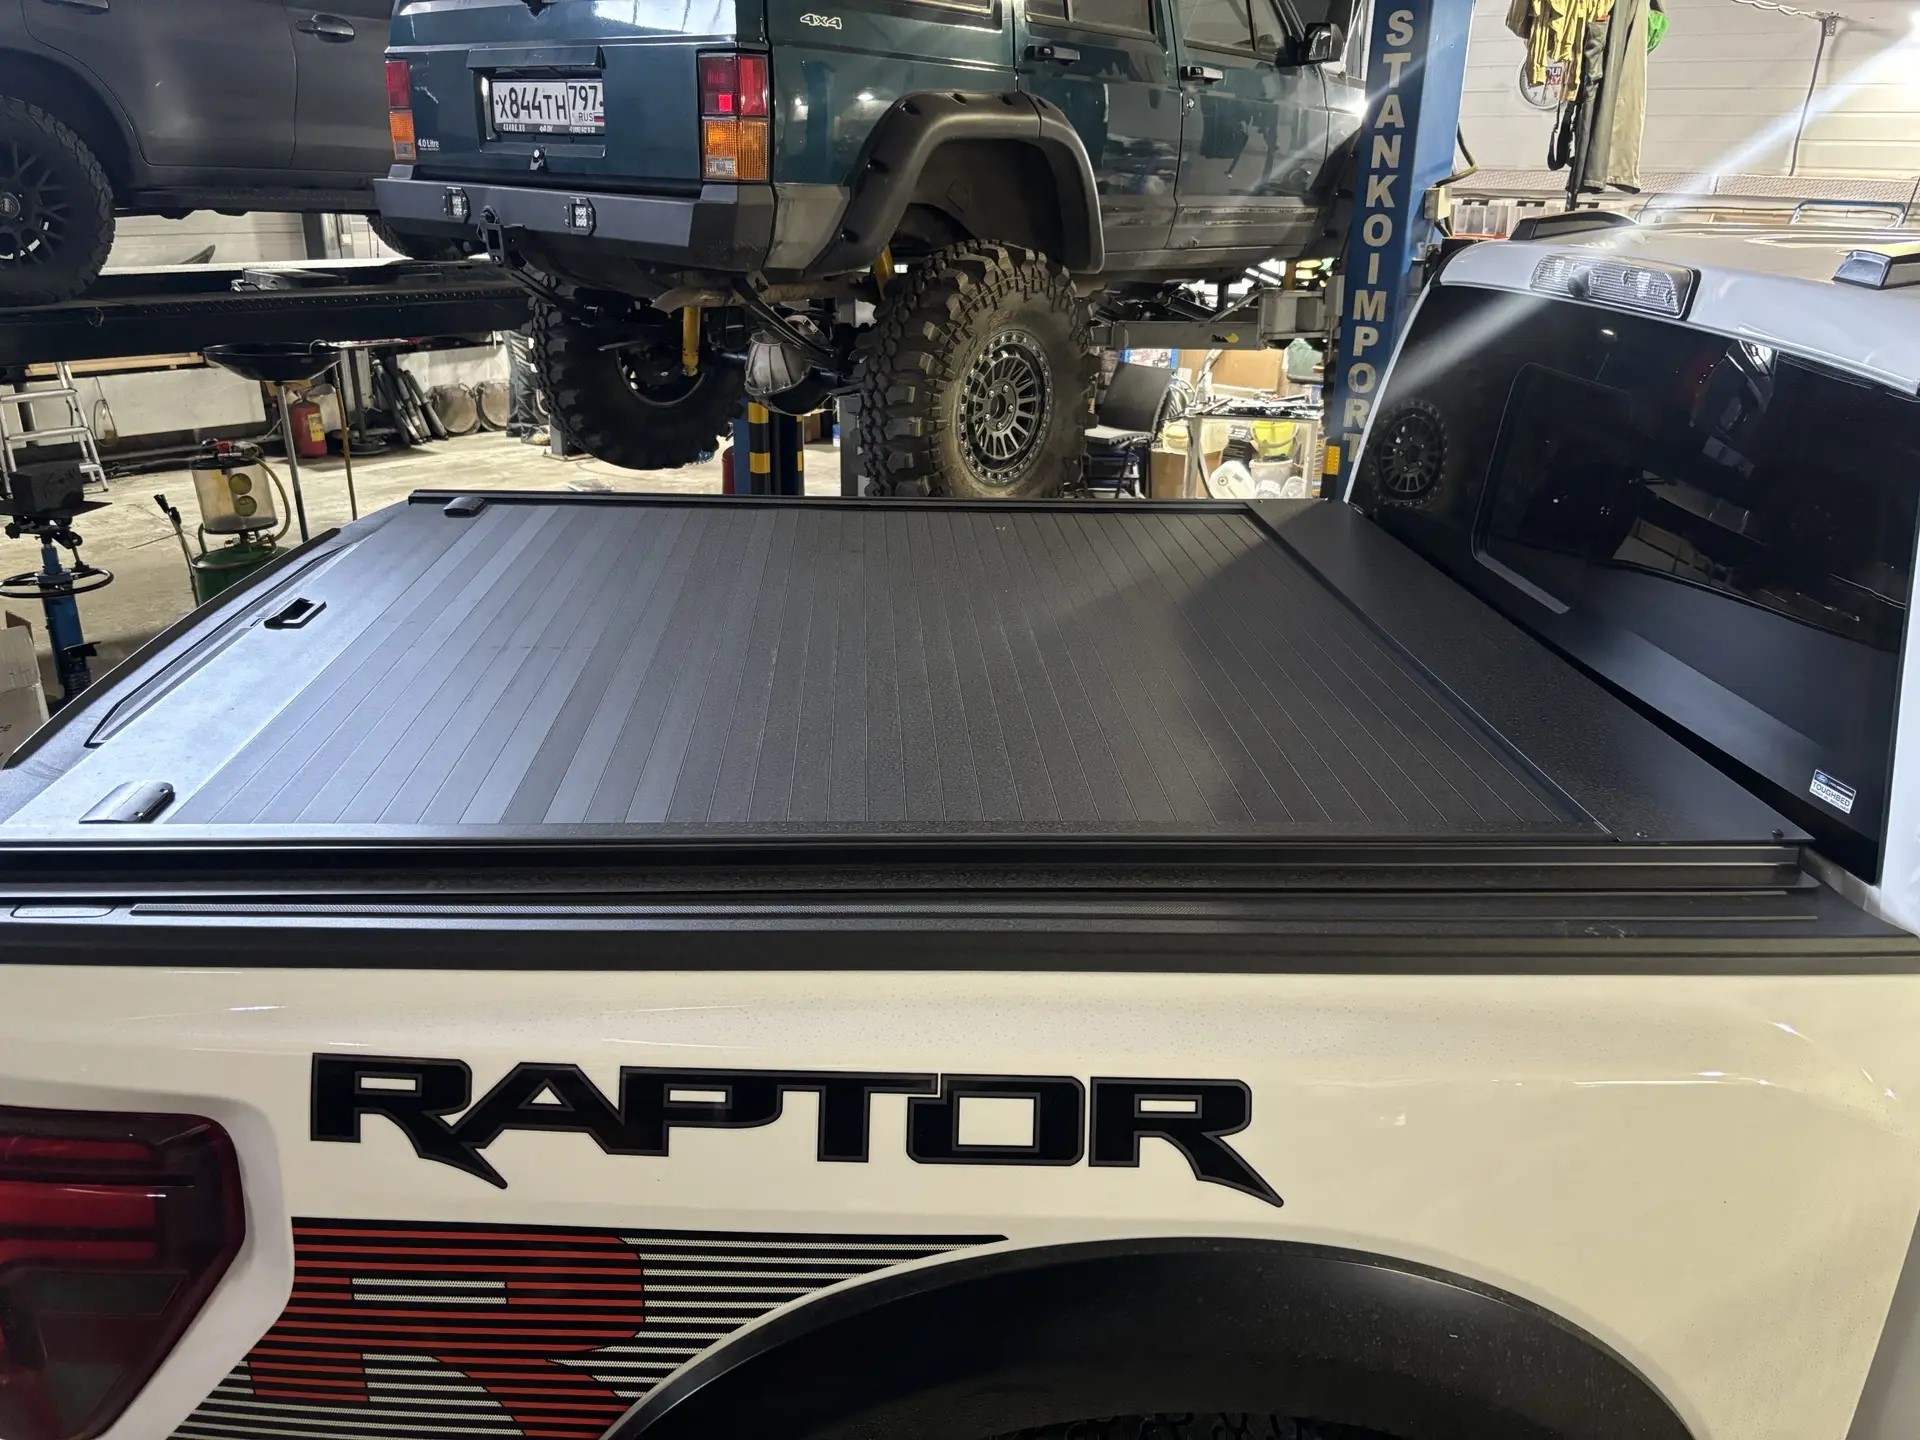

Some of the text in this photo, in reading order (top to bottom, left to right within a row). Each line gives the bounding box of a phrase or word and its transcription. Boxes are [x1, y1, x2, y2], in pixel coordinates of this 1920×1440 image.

[568, 85, 598, 110] 797
[578, 112, 594, 122] RUS
[1343, 9, 1415, 463] STANKOIMPORT
[1812, 781, 1851, 808] TOUGHBED
[310, 1052, 1285, 1208] RAPTOR
